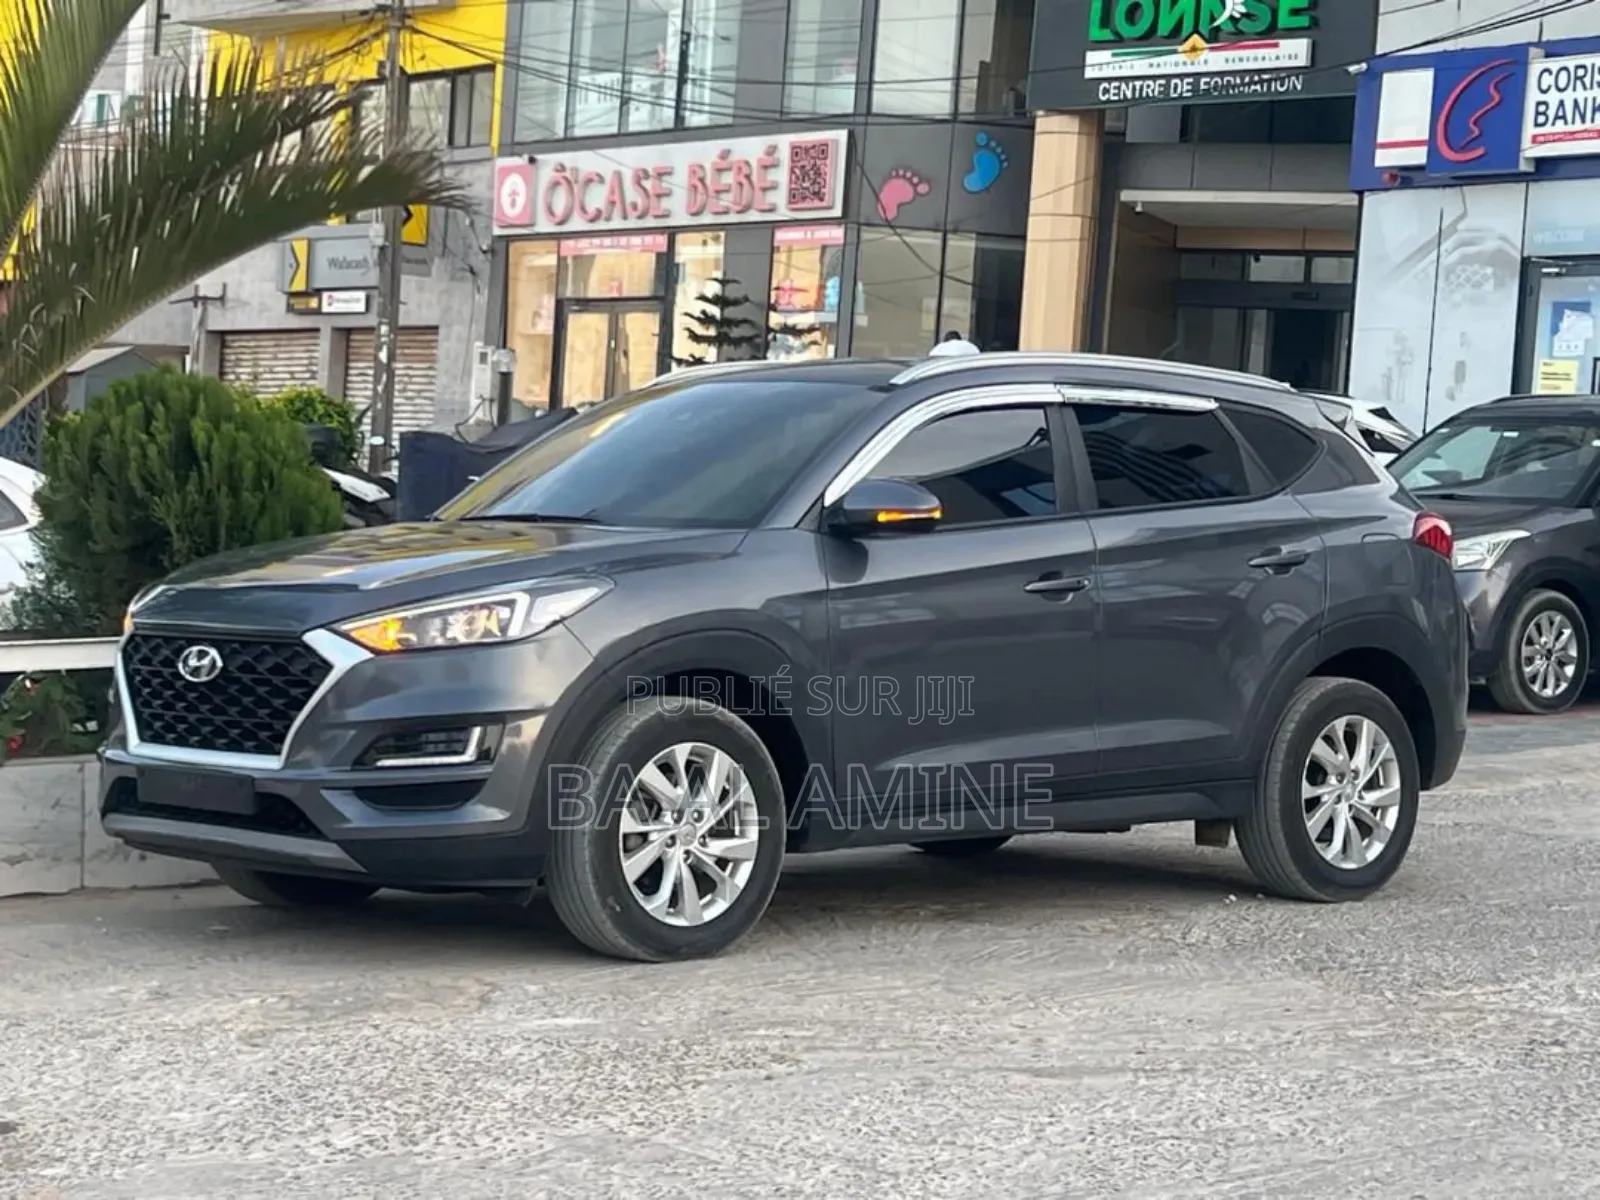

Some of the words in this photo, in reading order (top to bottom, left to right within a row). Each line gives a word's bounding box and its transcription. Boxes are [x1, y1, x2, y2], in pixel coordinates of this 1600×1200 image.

[1098, 80, 1166, 101] CENTRE
[1170, 78, 1194, 97] DE
[1200, 73, 1304, 96] FORMATION
[686, 144, 779, 216] BÉBÉ
